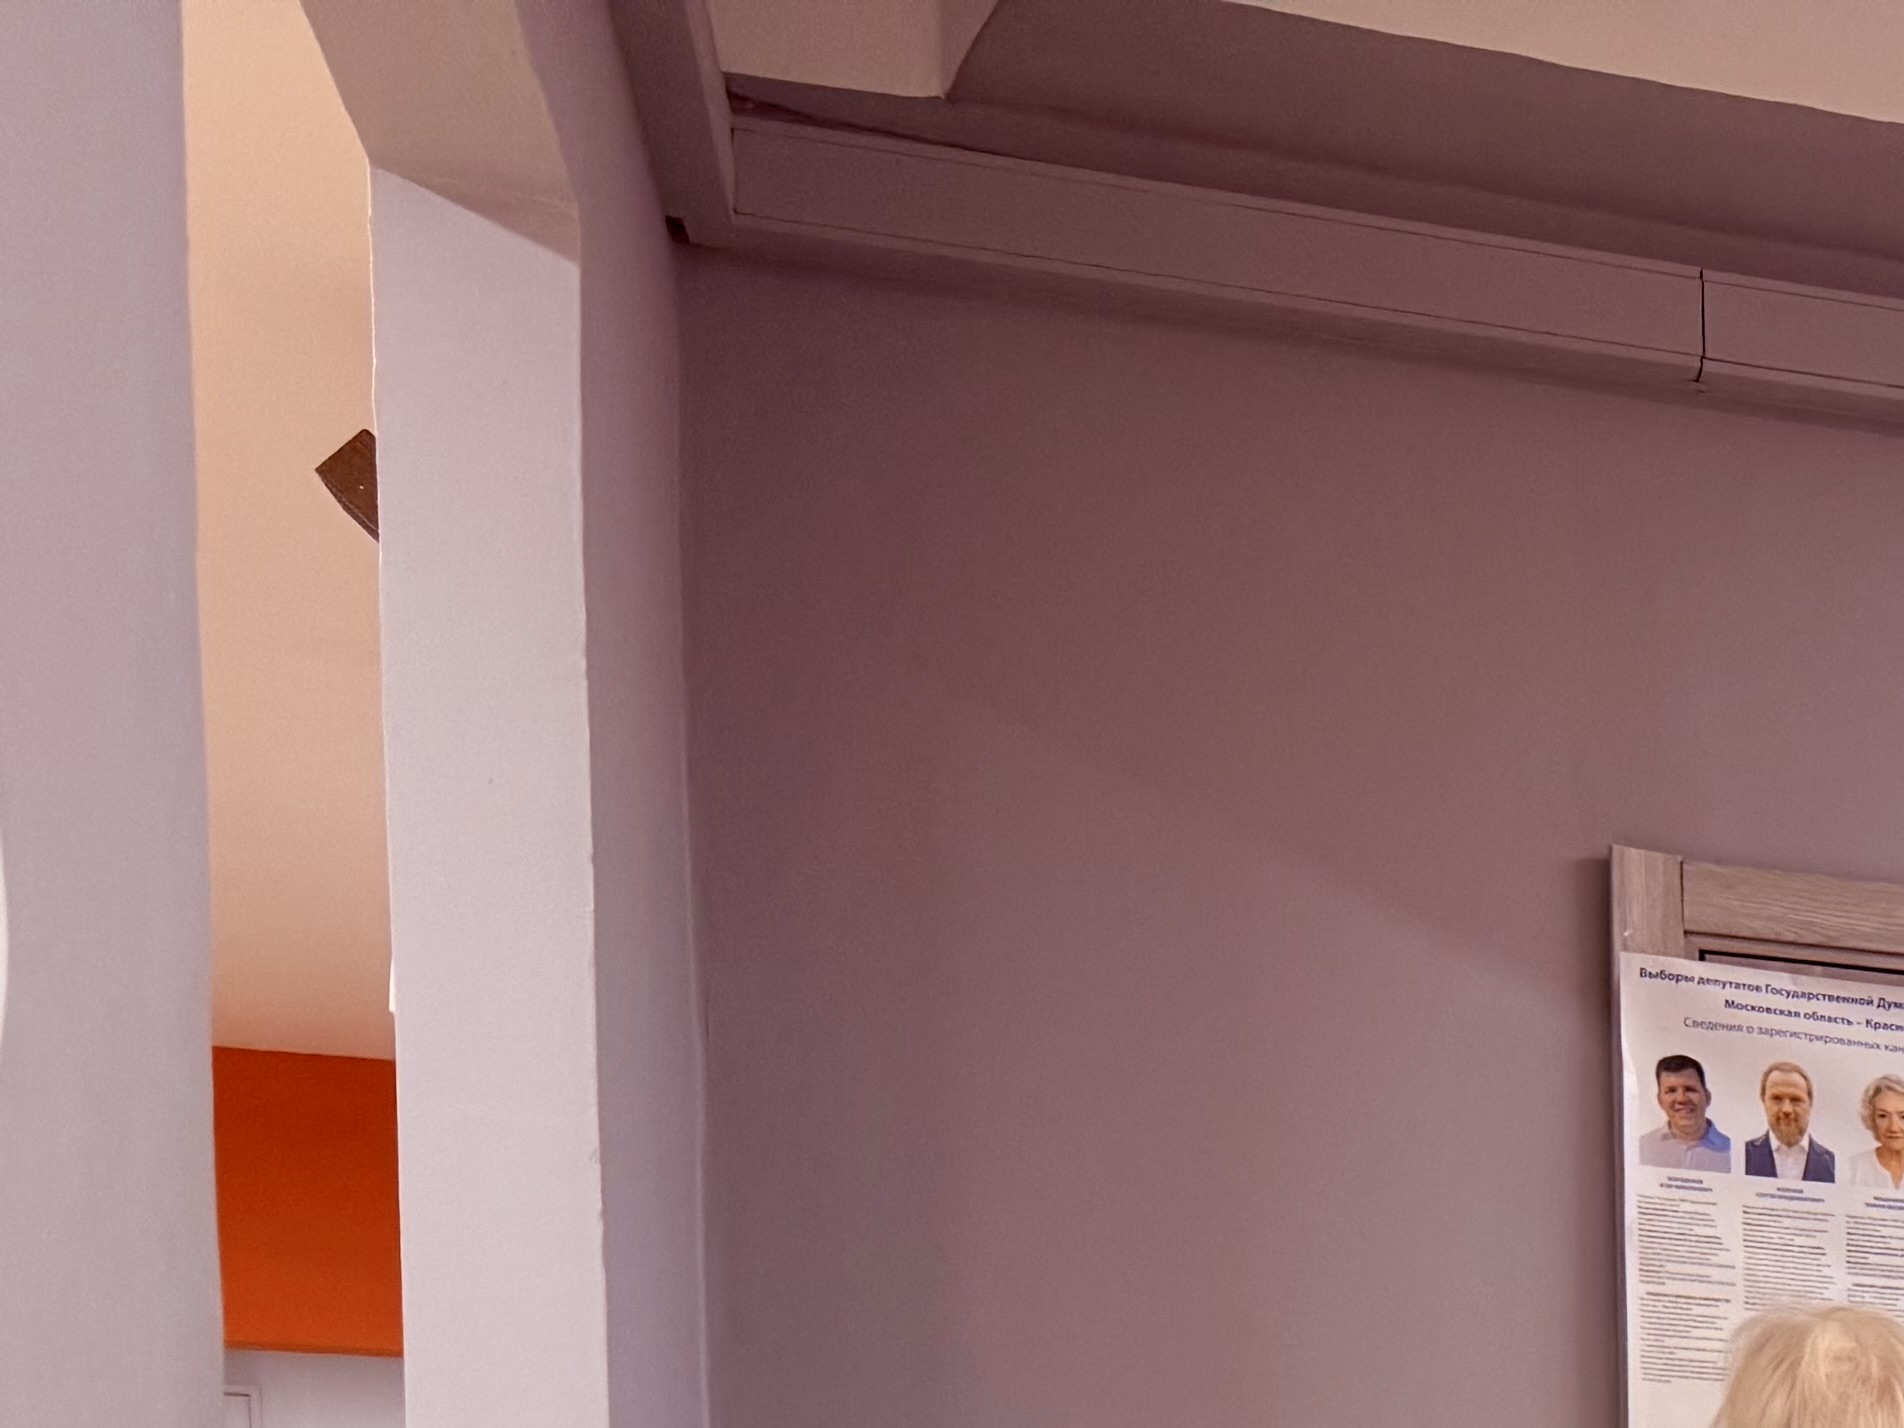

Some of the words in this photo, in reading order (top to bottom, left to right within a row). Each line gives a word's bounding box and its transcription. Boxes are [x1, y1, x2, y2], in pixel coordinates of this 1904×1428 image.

[1639, 967, 1695, 984] Выборы
[1697, 976, 1763, 994] депутатов
[1765, 984, 1874, 1007] Государственной
[1724, 999, 1801, 1019] Московская
[1803, 1011, 1854, 1027] область
[1746, 1025, 1755, 1034] о
